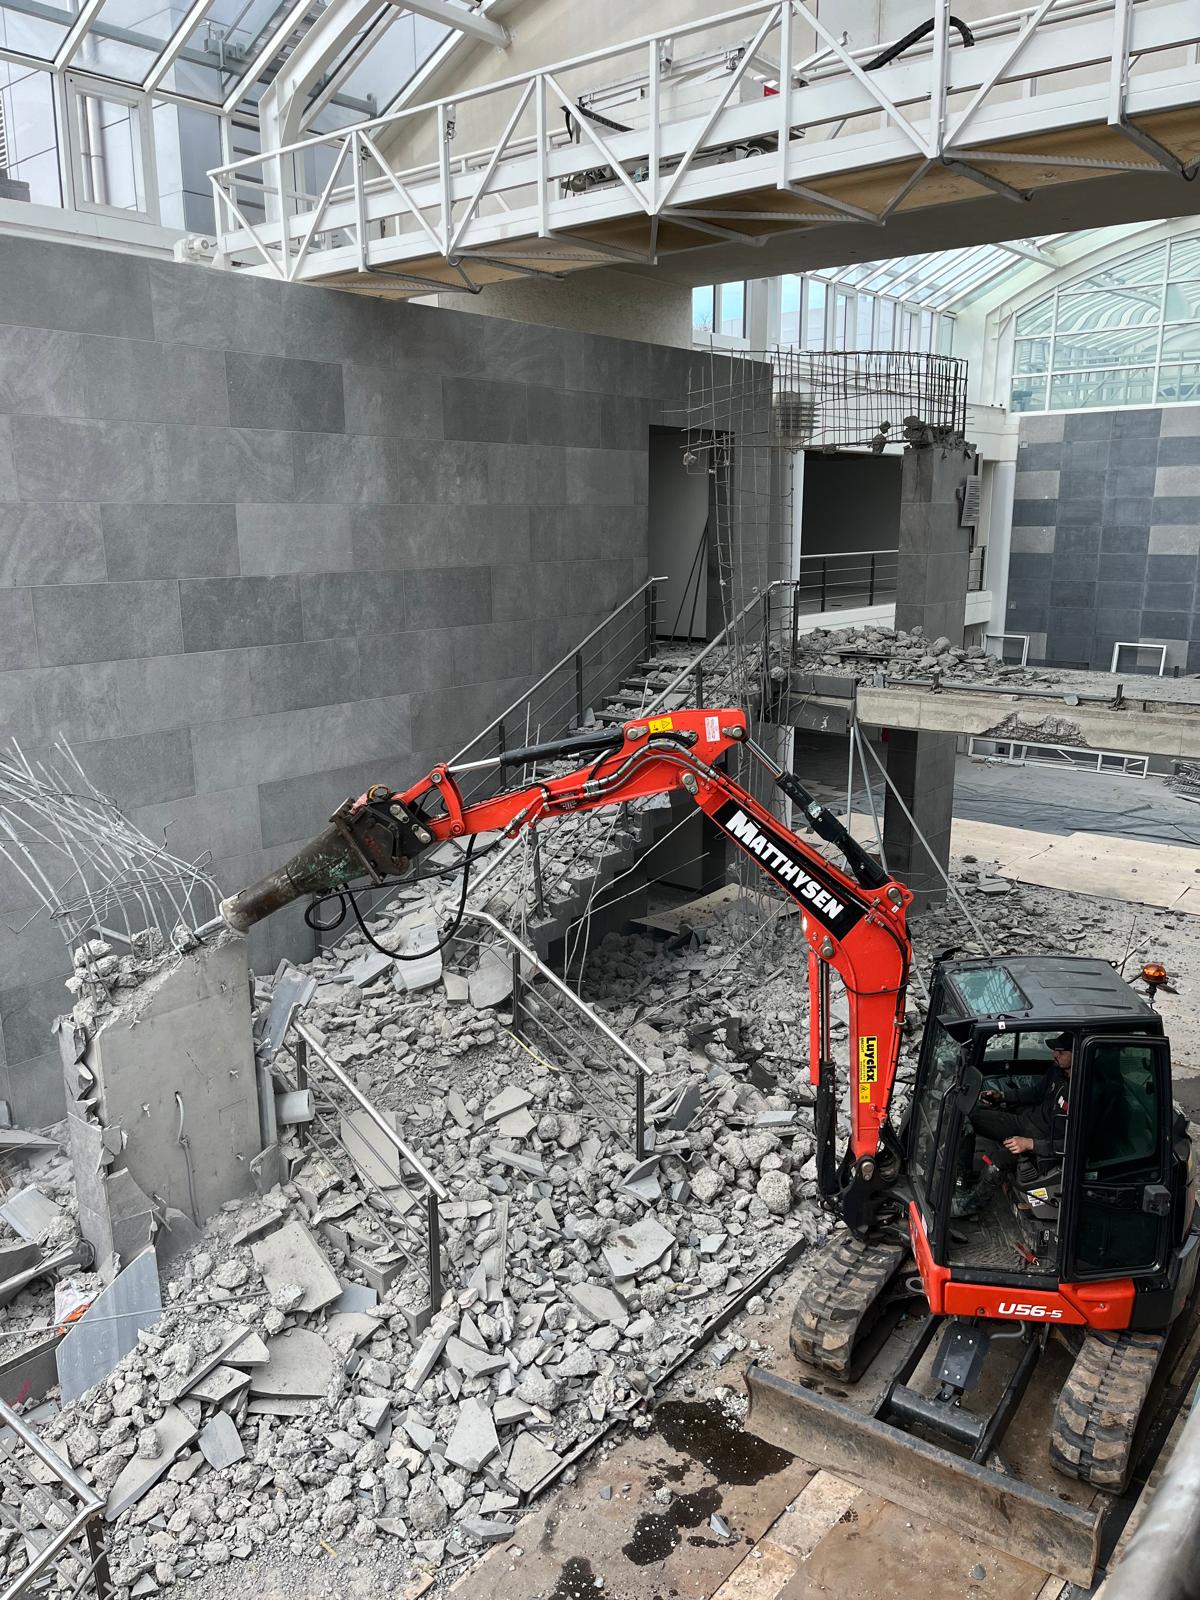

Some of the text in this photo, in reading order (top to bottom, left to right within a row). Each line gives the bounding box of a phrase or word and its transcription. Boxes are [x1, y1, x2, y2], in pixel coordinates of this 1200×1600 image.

[725, 810, 844, 919] MATTHYSEN
[864, 1037, 876, 1081] Luyckx
[998, 1302, 1063, 1318] U56-5
